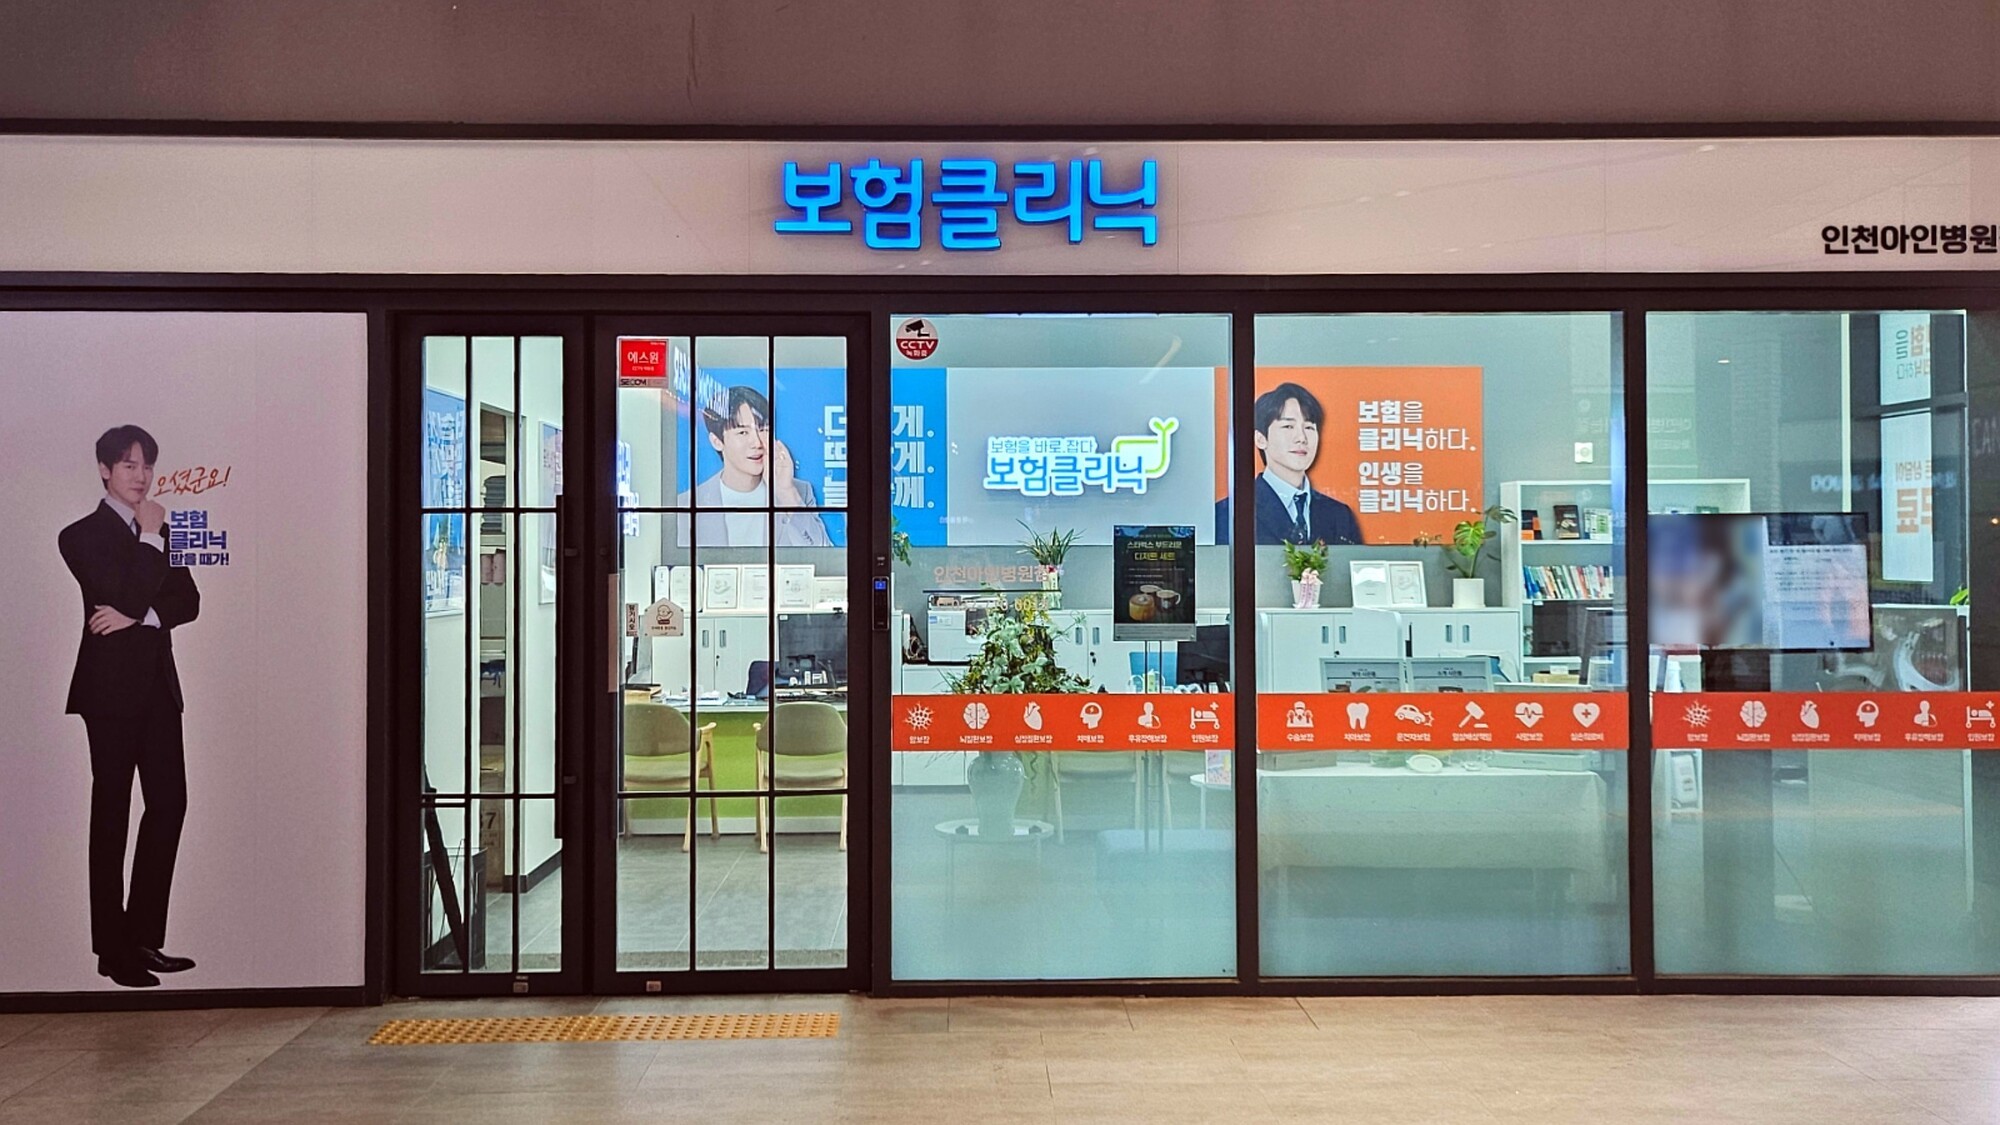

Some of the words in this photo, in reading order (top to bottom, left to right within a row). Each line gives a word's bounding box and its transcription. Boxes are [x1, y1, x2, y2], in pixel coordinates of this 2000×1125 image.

[775, 158, 1158, 250] 보험클리닉
[1821, 224, 2000, 254] 인천아인병원
[900, 340, 935, 349] CCTV
[627, 351, 659, 365] 에스원
[1358, 400, 1424, 424] 보험을
[991, 439, 1030, 454] 보험을
[1358, 428, 1477, 452] 클리닉하다.
[153, 466, 231, 496] 오셨군요!
[987, 456, 1143, 492] 보험클리닉
[1358, 462, 1424, 486] 인생을
[1358, 489, 1477, 513] 클리닉하다.
[171, 510, 208, 529] 보험
[171, 531, 227, 549] 클리닉
[171, 552, 197, 566] 받을
[199, 552, 229, 566] 때가!
